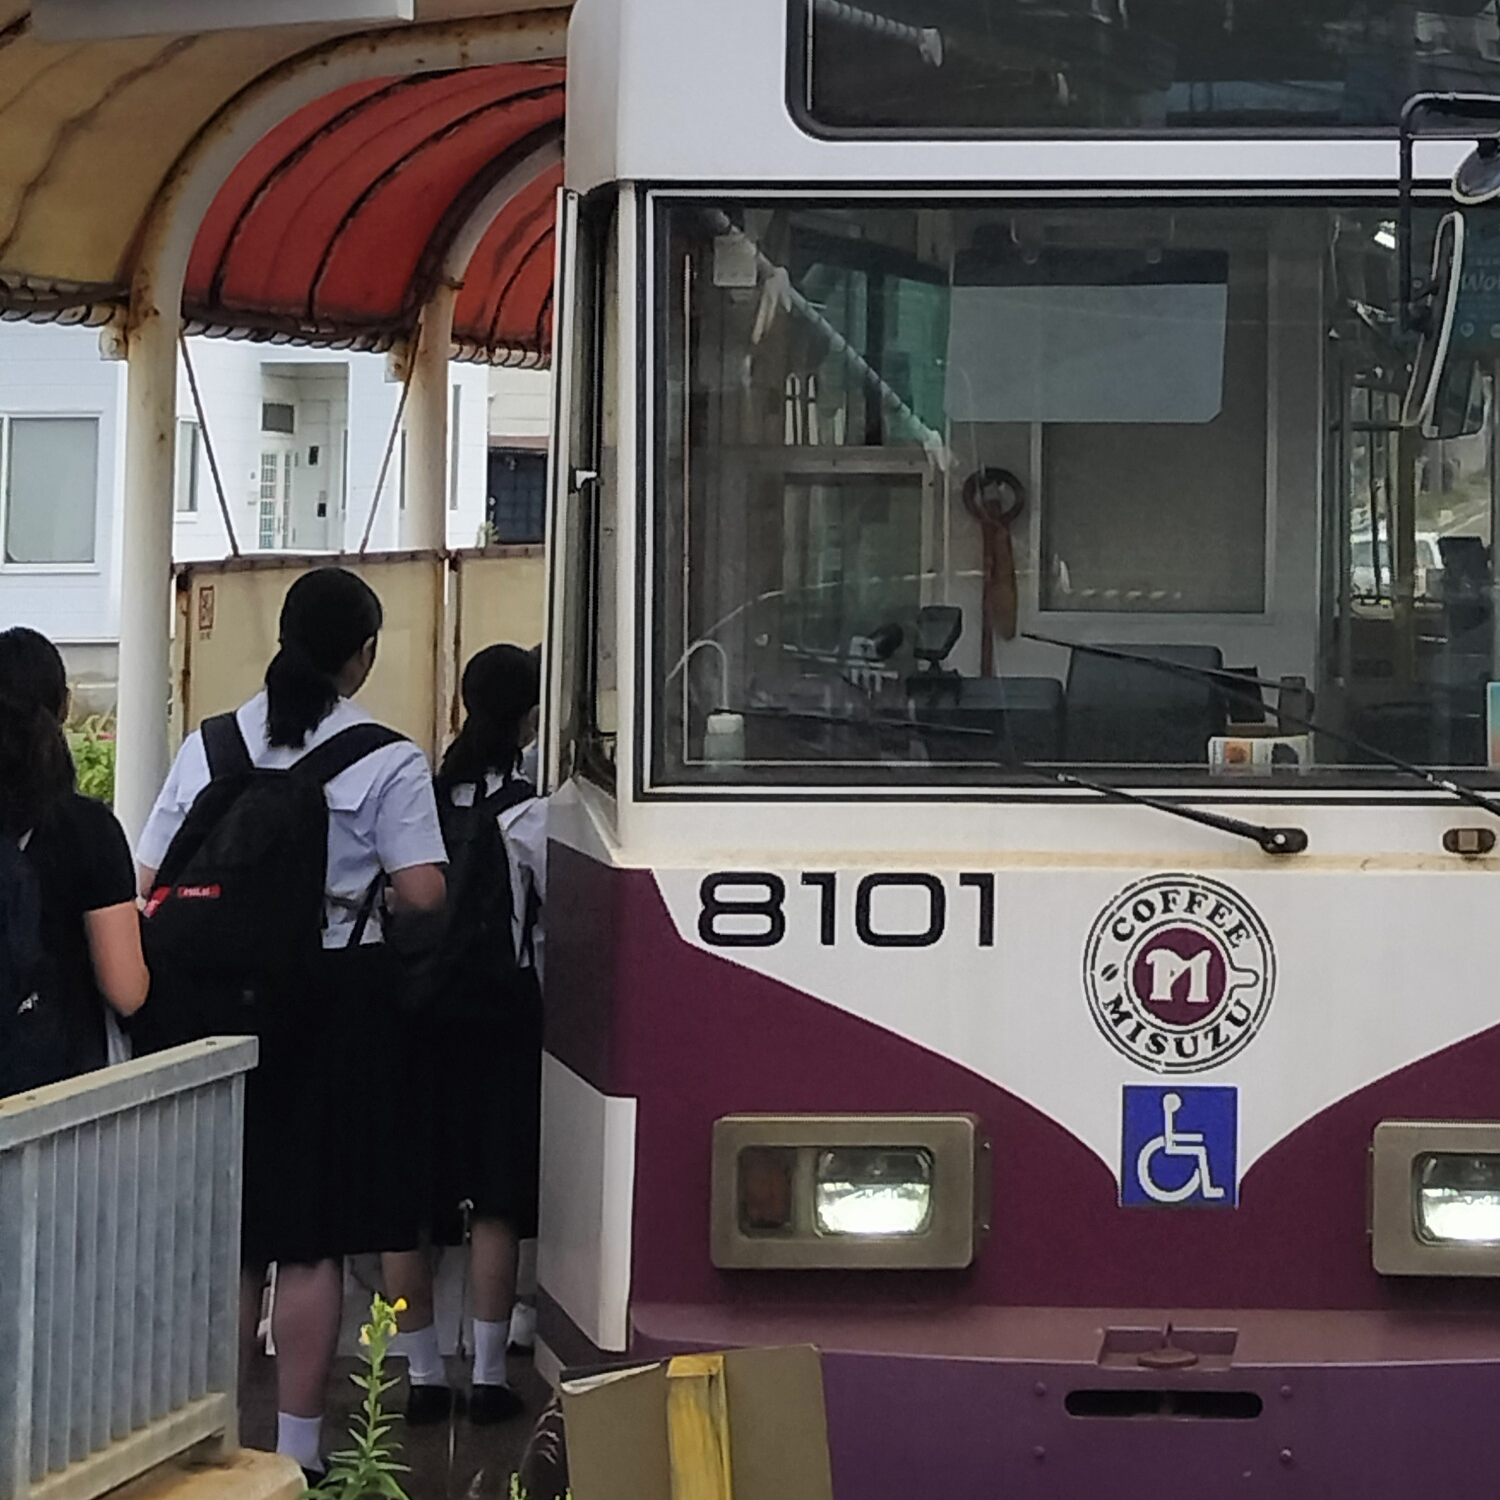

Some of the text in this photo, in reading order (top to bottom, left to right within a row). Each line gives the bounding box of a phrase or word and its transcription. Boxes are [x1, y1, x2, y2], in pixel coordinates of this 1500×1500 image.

[698, 871, 996, 948] 8101
[1111, 888, 1252, 949] COFFEE
[1102, 992, 1252, 1059] MISUZU
